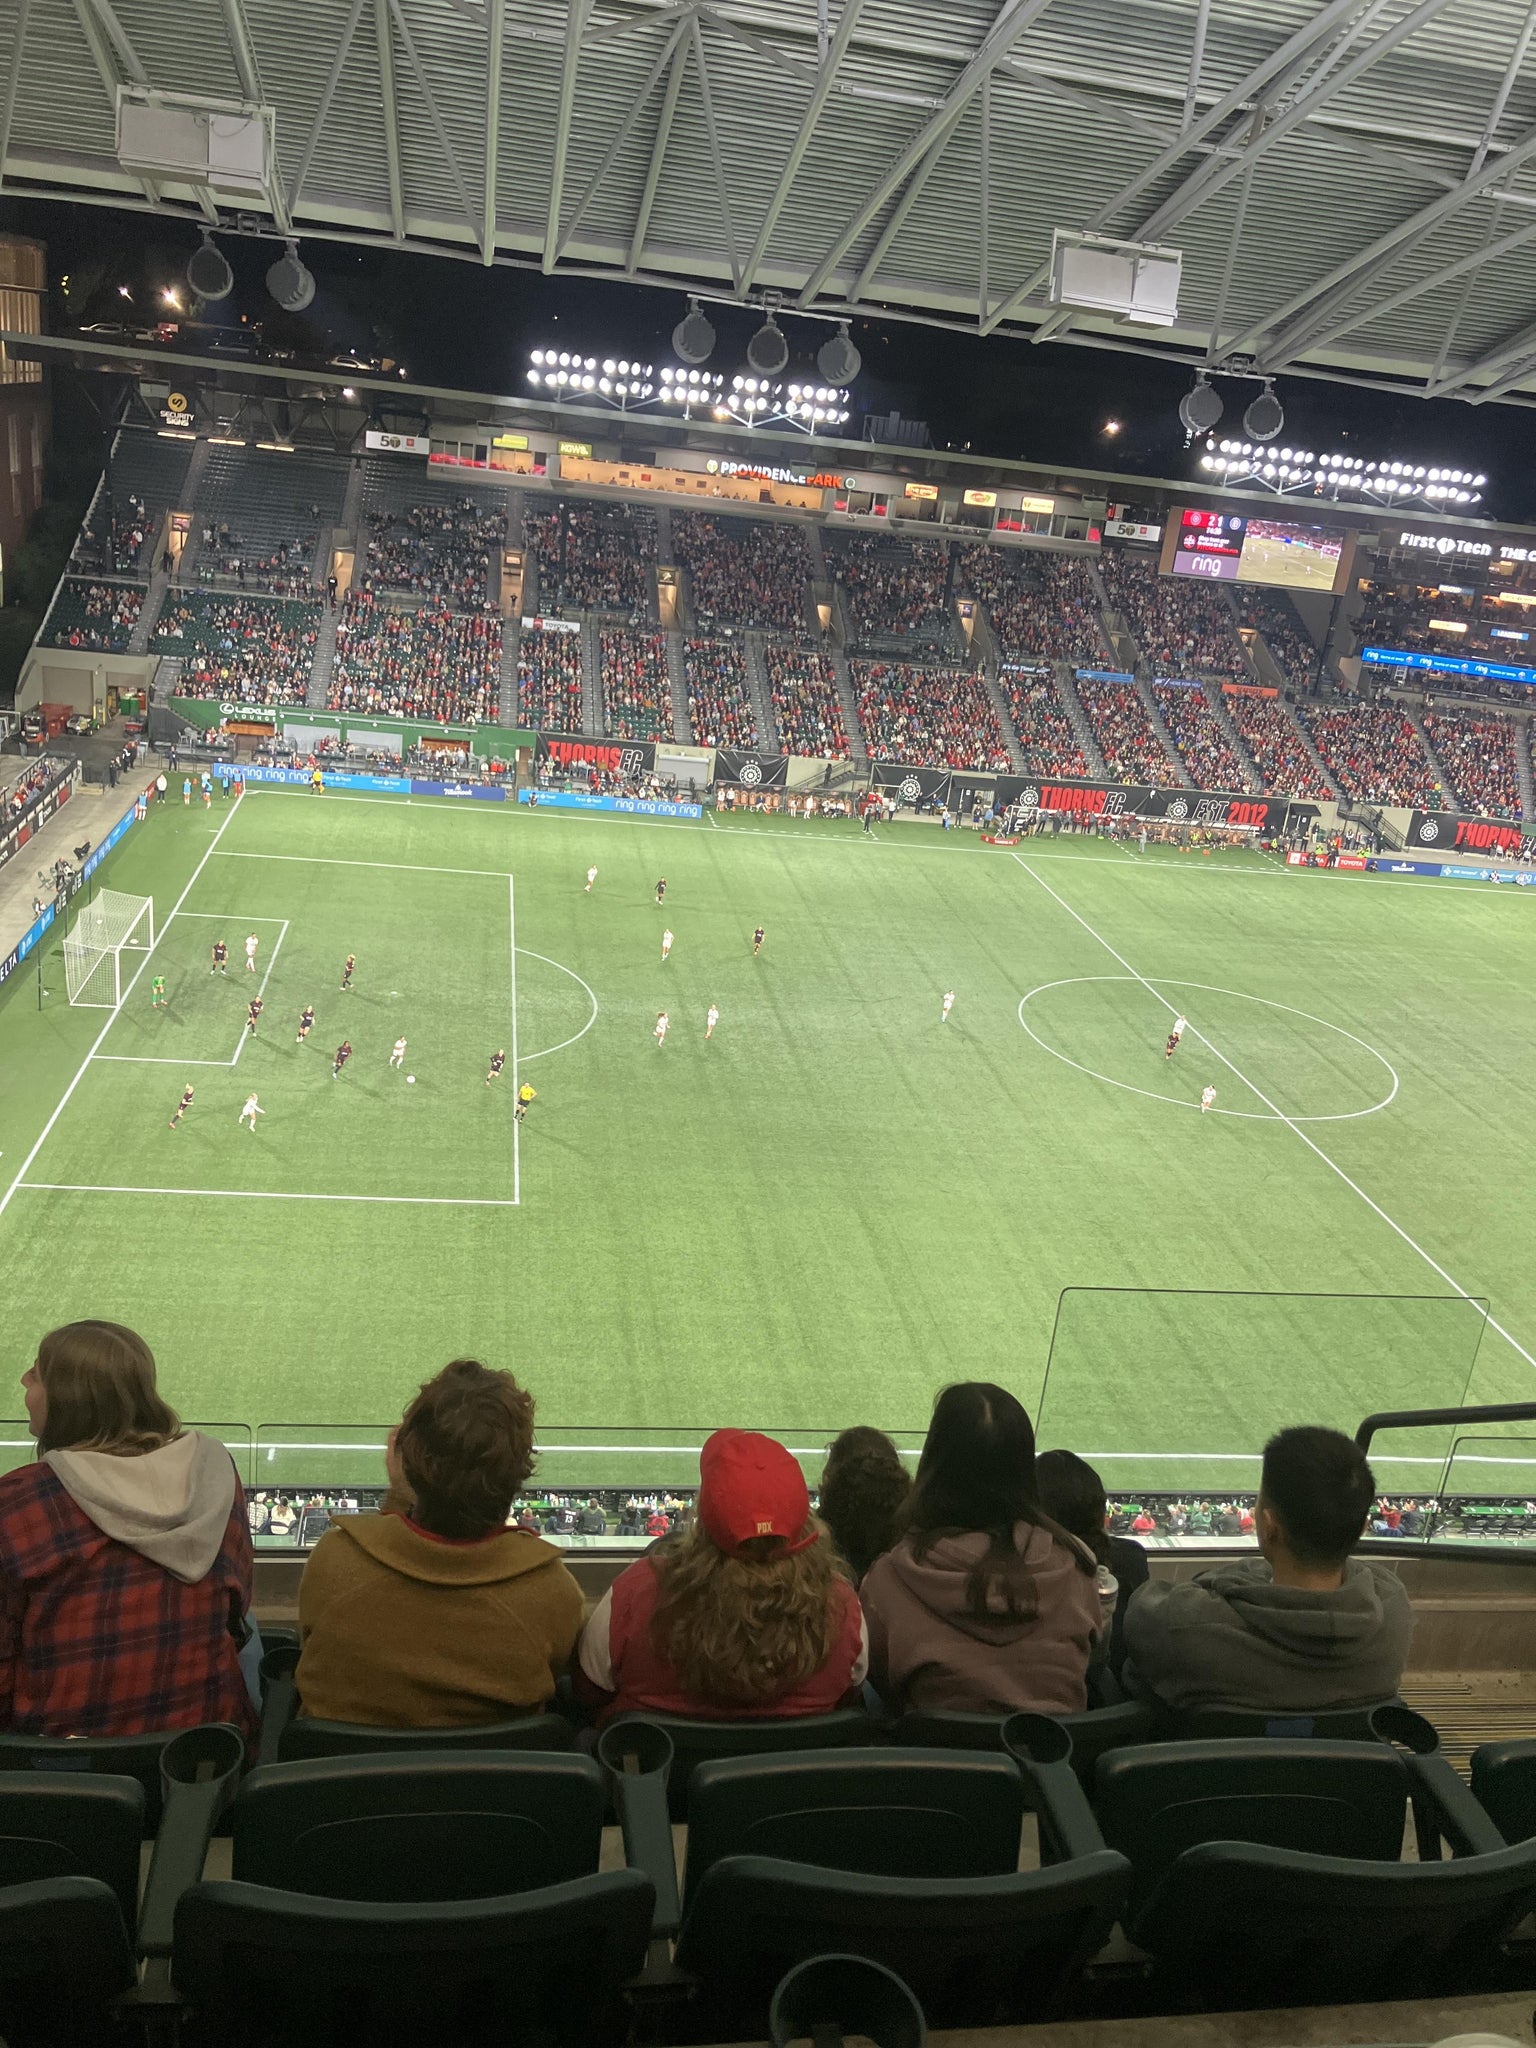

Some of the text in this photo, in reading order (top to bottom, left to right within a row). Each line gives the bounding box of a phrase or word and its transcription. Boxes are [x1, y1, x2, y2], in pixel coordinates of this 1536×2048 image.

[160, 410, 195, 421] SECURITY
[1208, 516, 1217, 526] 2
[1400, 532, 1437, 550] First
[1457, 540, 1493, 557] Tech
[1500, 546, 1528, 560] THE
[1192, 555, 1222, 577] ring
[545, 622, 569, 630] TOYOTA
[1366, 651, 1379, 661] ring
[1419, 657, 1433, 667] ring
[1475, 664, 1489, 675] ring
[235, 706, 276, 717] LEXUS
[234, 713, 276, 722] LOUNGE
[547, 741, 622, 772] THORNS
[266, 768, 285, 782] ring
[289, 770, 309, 784] ring
[1040, 786, 1127, 816] THORNS FC
[615, 799, 698, 817] ring ring ring ring
[1227, 801, 1269, 827] 2012
[1455, 821, 1523, 850] THORNS
[1340, 859, 1363, 867] TOYOTA
[564, 1514, 574, 1524] 13
[757, 1521, 772, 1534] PDX
